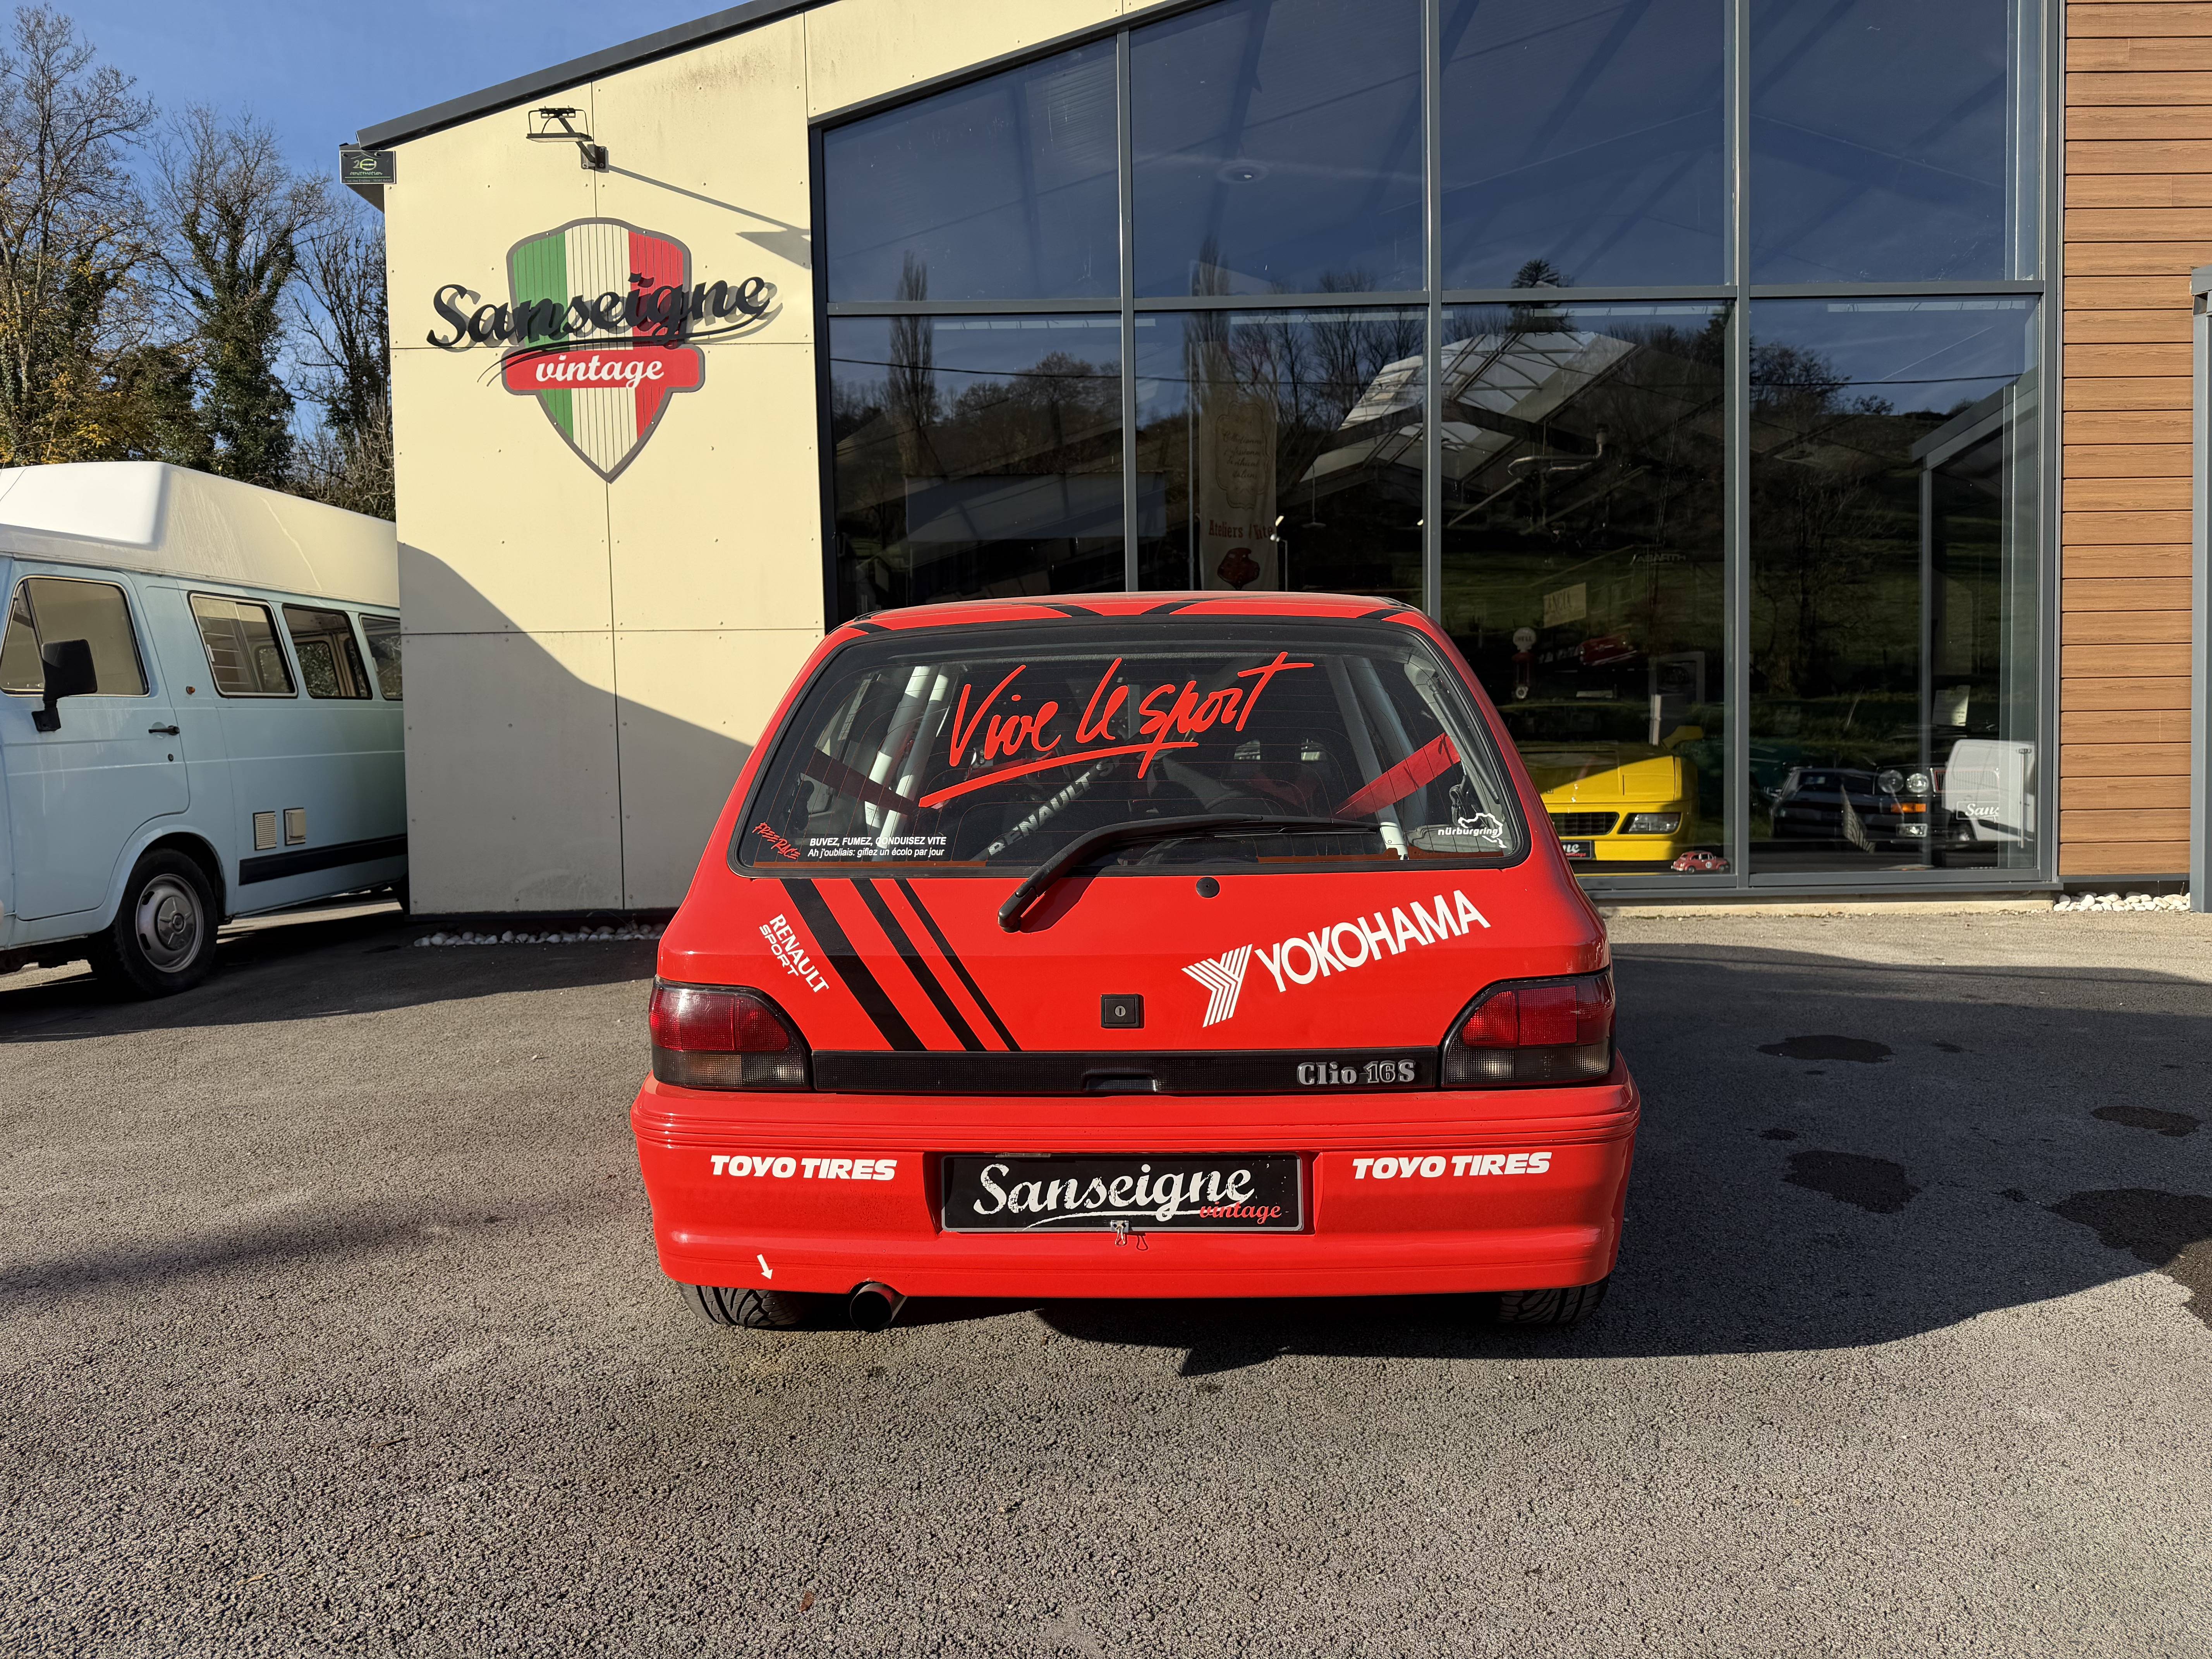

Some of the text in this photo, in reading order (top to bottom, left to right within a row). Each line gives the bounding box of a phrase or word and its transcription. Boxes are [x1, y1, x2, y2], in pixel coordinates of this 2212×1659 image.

[427, 272, 770, 349] Sanseigne
[536, 355, 664, 388] vintage
[1209, 520, 1243, 538] Ateliers
[950, 652, 1314, 779] Vive le sport
[752, 822, 801, 860] FREE RACE
[809, 836, 947, 847] BUVEZ, FUMEZ, CONDUISEZ VITE
[1437, 827, 1498, 836] nürburgring
[807, 848, 819, 857] Ah
[819, 848, 855, 859] j'oubliais:
[857, 847, 878, 858] giflez
[891, 847, 913, 856] écolo
[914, 849, 928, 858] par
[928, 847, 945, 858] jour
[759, 924, 799, 976] SPORT
[769, 914, 830, 993] RENAULT
[1254, 890, 1491, 993] YOKOHAMA
[1297, 1062, 1415, 1085] Clio 16S
[710, 1155, 897, 1181] TOYO TIRES
[1352, 1152, 1552, 1179] TOYO TIRES
[973, 1163, 1255, 1221] Sanseigne
[1199, 1201, 1281, 1224] vintage
